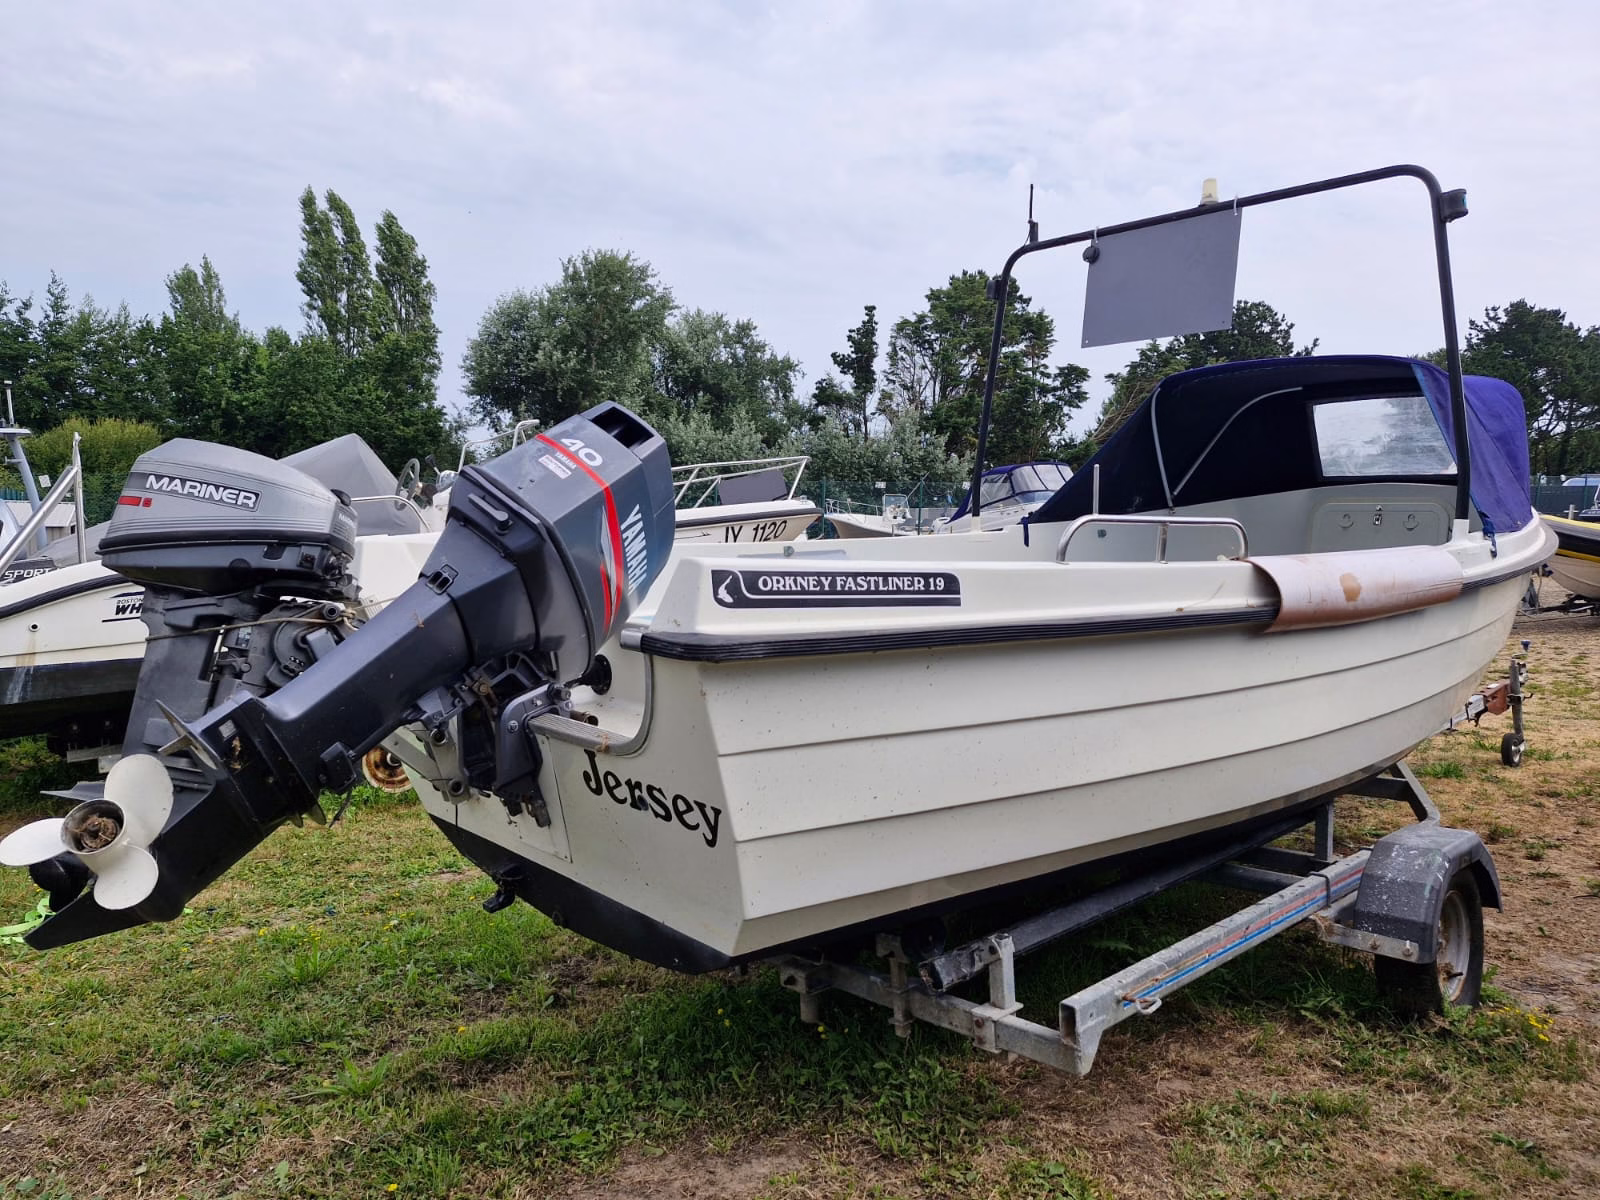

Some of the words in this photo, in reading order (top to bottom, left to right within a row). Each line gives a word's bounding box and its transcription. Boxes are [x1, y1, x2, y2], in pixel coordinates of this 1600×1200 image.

[560, 438, 603, 467] 40
[145, 474, 257, 508] MARINER
[752, 519, 788, 543] 1120
[620, 503, 648, 597] YAMAHA
[758, 575, 831, 591] ORKNEY
[836, 576, 925, 592] FASTLINER
[928, 577, 945, 592] 19
[582, 748, 722, 848] Jersey
